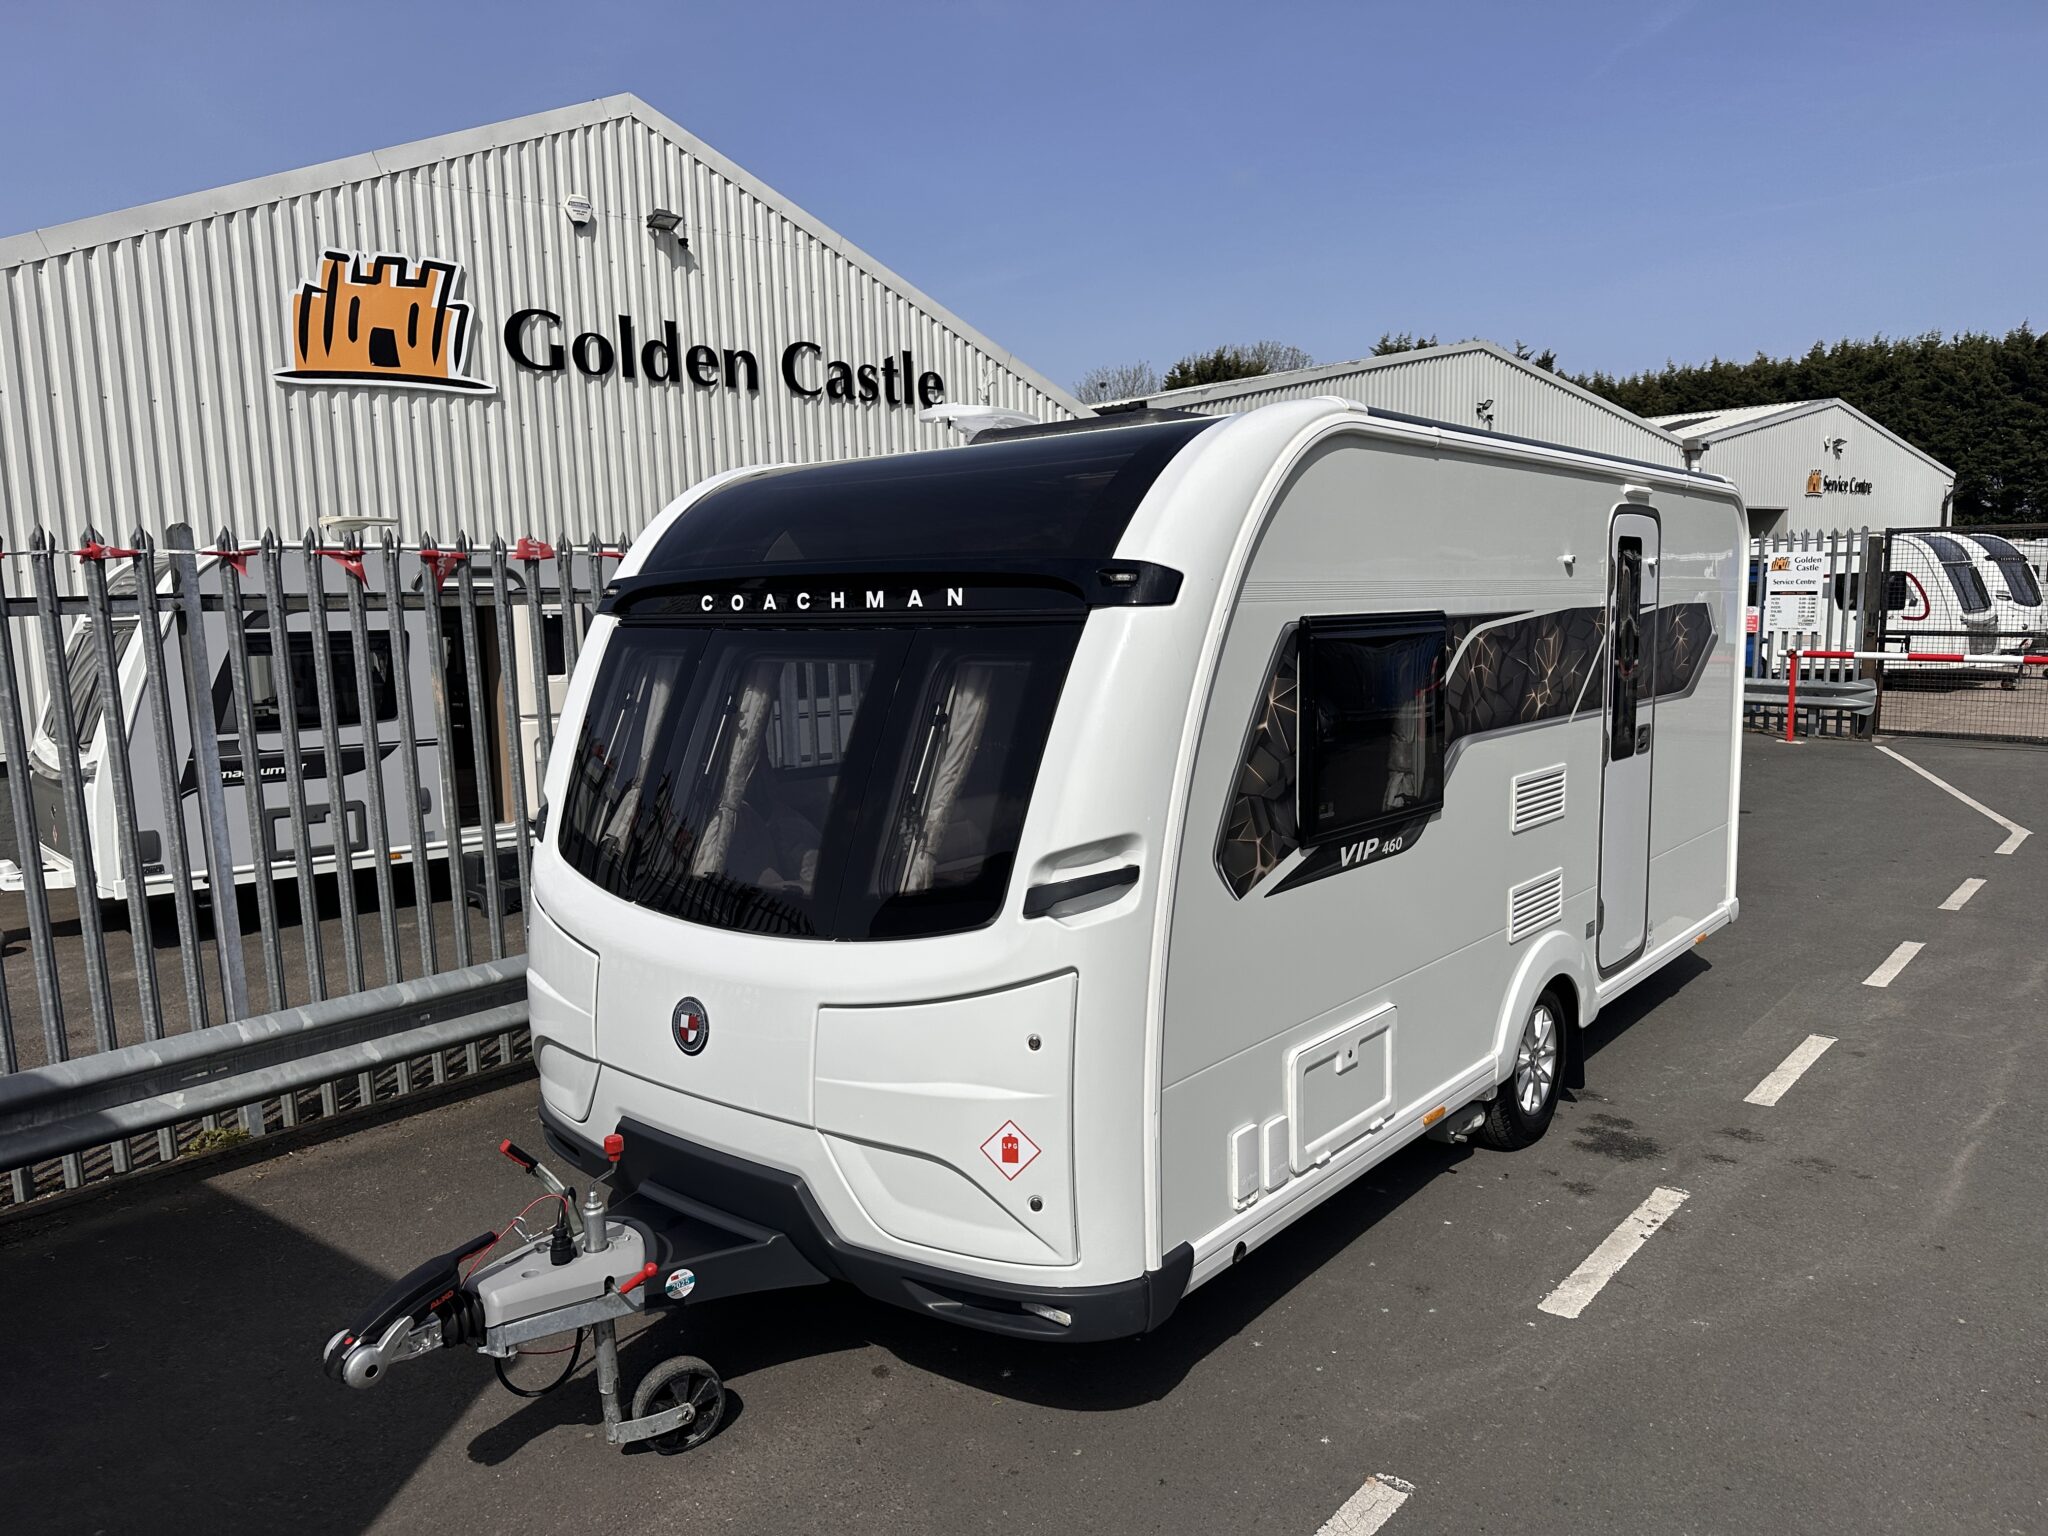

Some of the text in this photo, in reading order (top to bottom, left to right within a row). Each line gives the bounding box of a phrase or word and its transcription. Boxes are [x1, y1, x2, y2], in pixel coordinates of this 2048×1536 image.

[503, 308, 945, 410] Golden Castle
[1823, 475, 1849, 493] Service
[1794, 555, 1822, 564] Golden
[1796, 564, 1820, 572] Castle
[700, 587, 964, 612] COACHMAN
[1340, 836, 1403, 868] VIP 460
[671, 1278, 690, 1291] 2025
